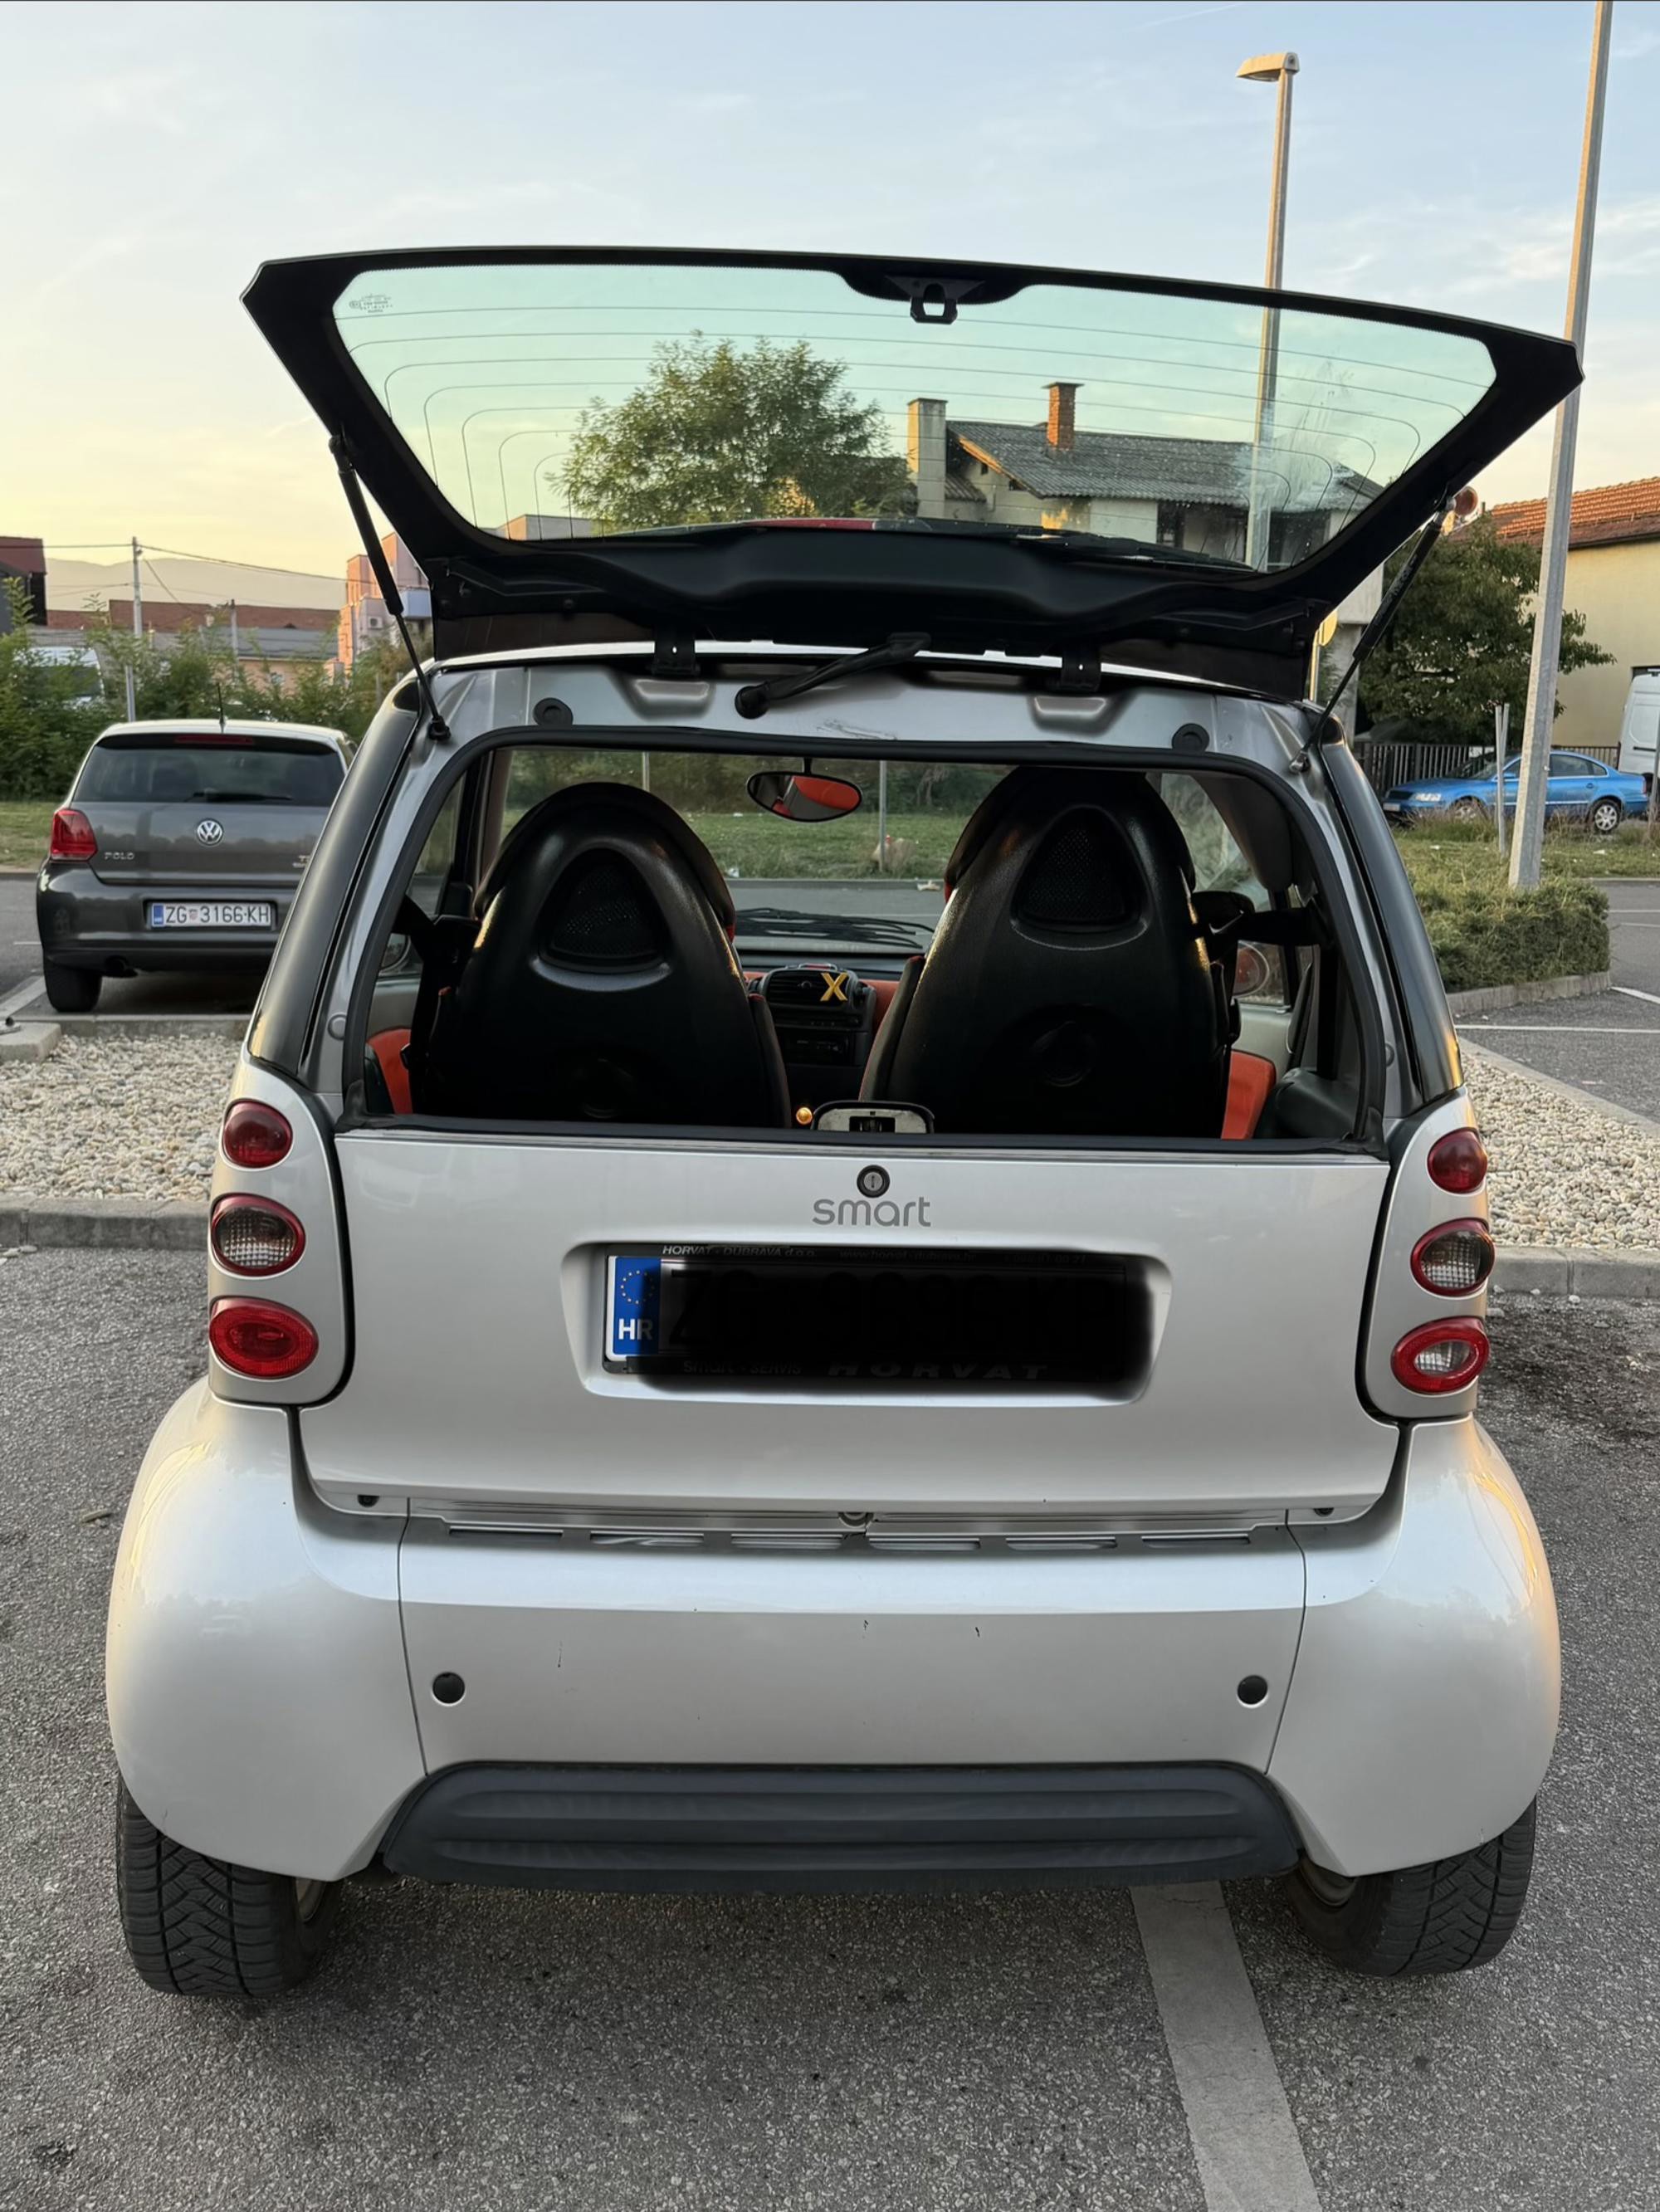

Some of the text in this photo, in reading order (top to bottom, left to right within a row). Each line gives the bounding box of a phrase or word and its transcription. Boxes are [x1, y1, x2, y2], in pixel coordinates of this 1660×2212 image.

[104, 852, 134, 860] POLO
[166, 906, 187, 923] ZG
[820, 973, 847, 1001] X
[813, 1197, 931, 1227] smart
[662, 1245, 710, 1255] HORVAT
[618, 1318, 653, 1340] HR
